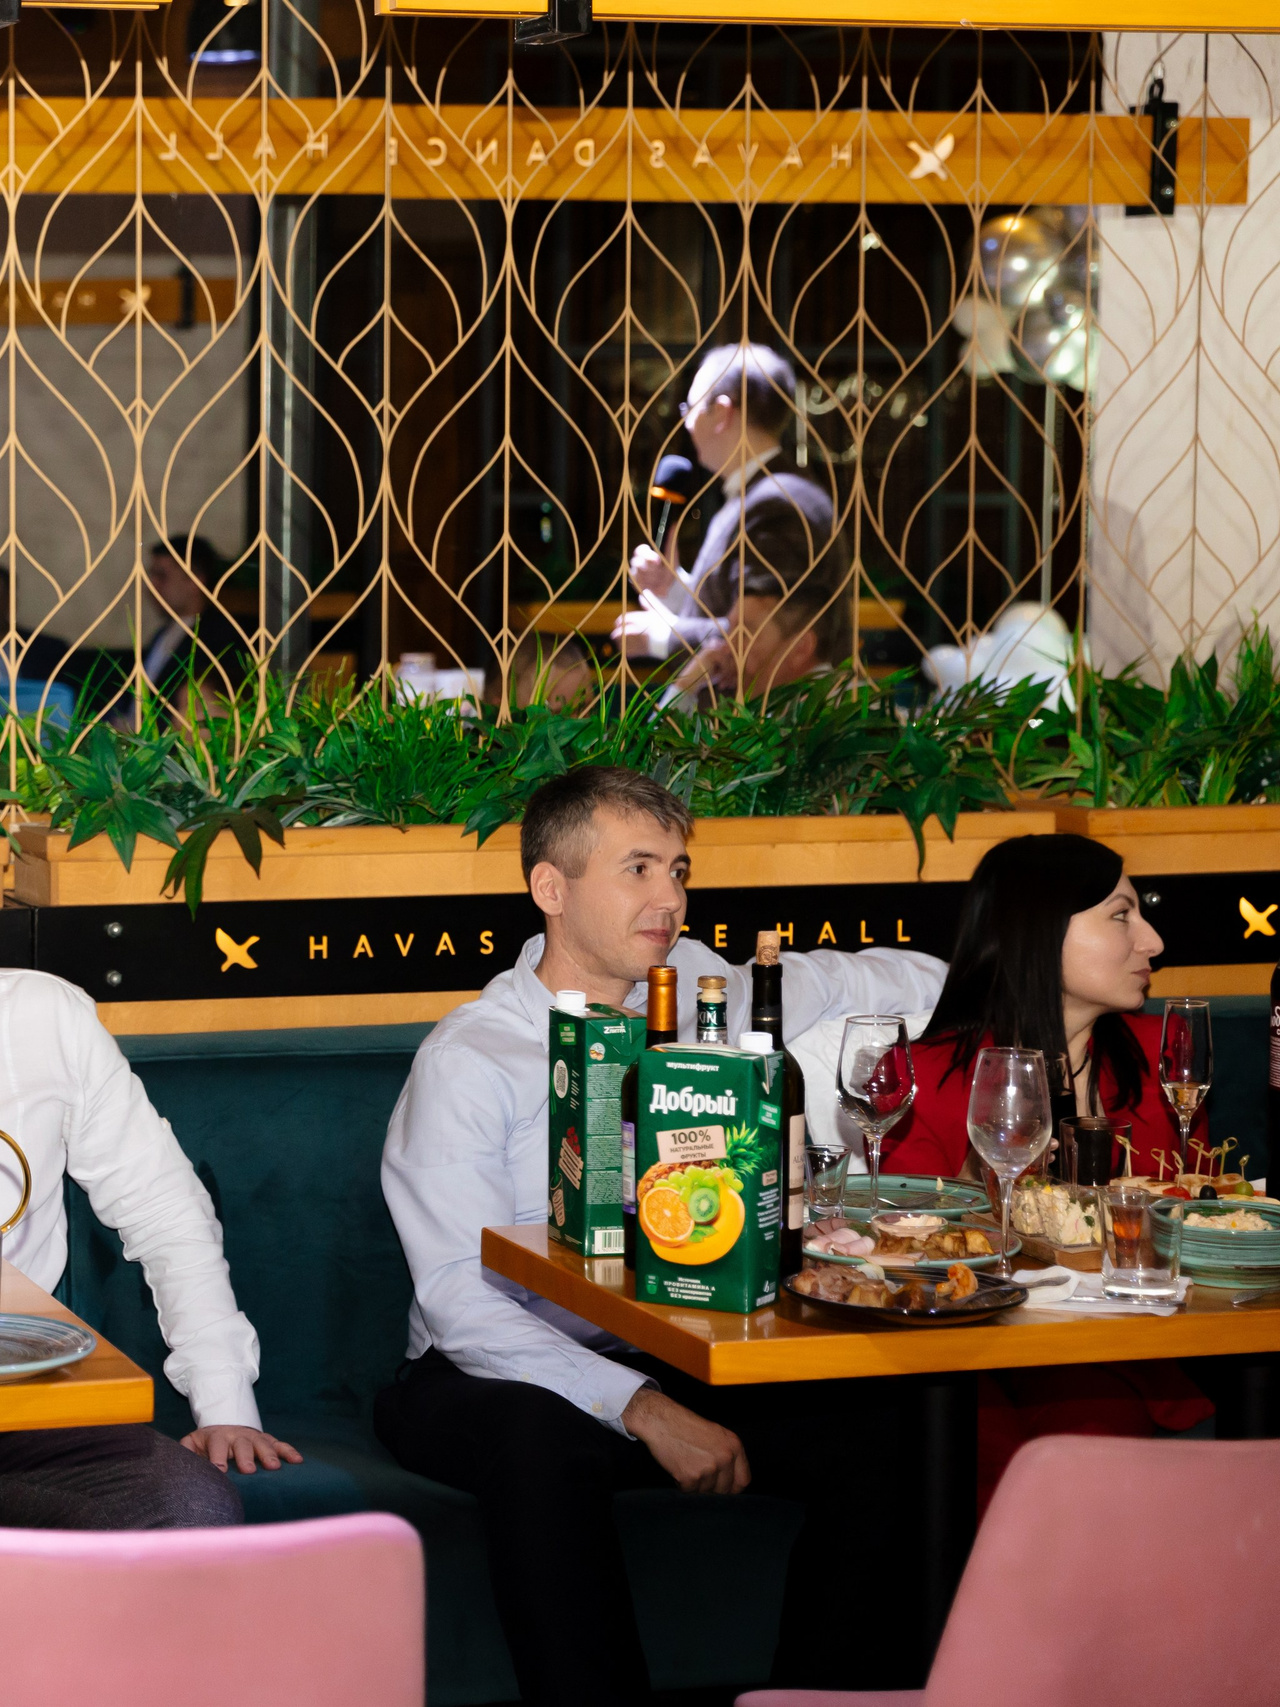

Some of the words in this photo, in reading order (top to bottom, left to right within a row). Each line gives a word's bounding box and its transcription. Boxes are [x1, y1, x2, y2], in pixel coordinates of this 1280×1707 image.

[309, 930, 494, 960] HAVAS
[776, 919, 911, 946] HALL
[666, 1061, 720, 1072] мультифрукт
[649, 1084, 736, 1117] Добрый
[671, 1129, 711, 1145] 100%
[670, 1143, 714, 1153] НАТУРАЛЬНЫЕ
